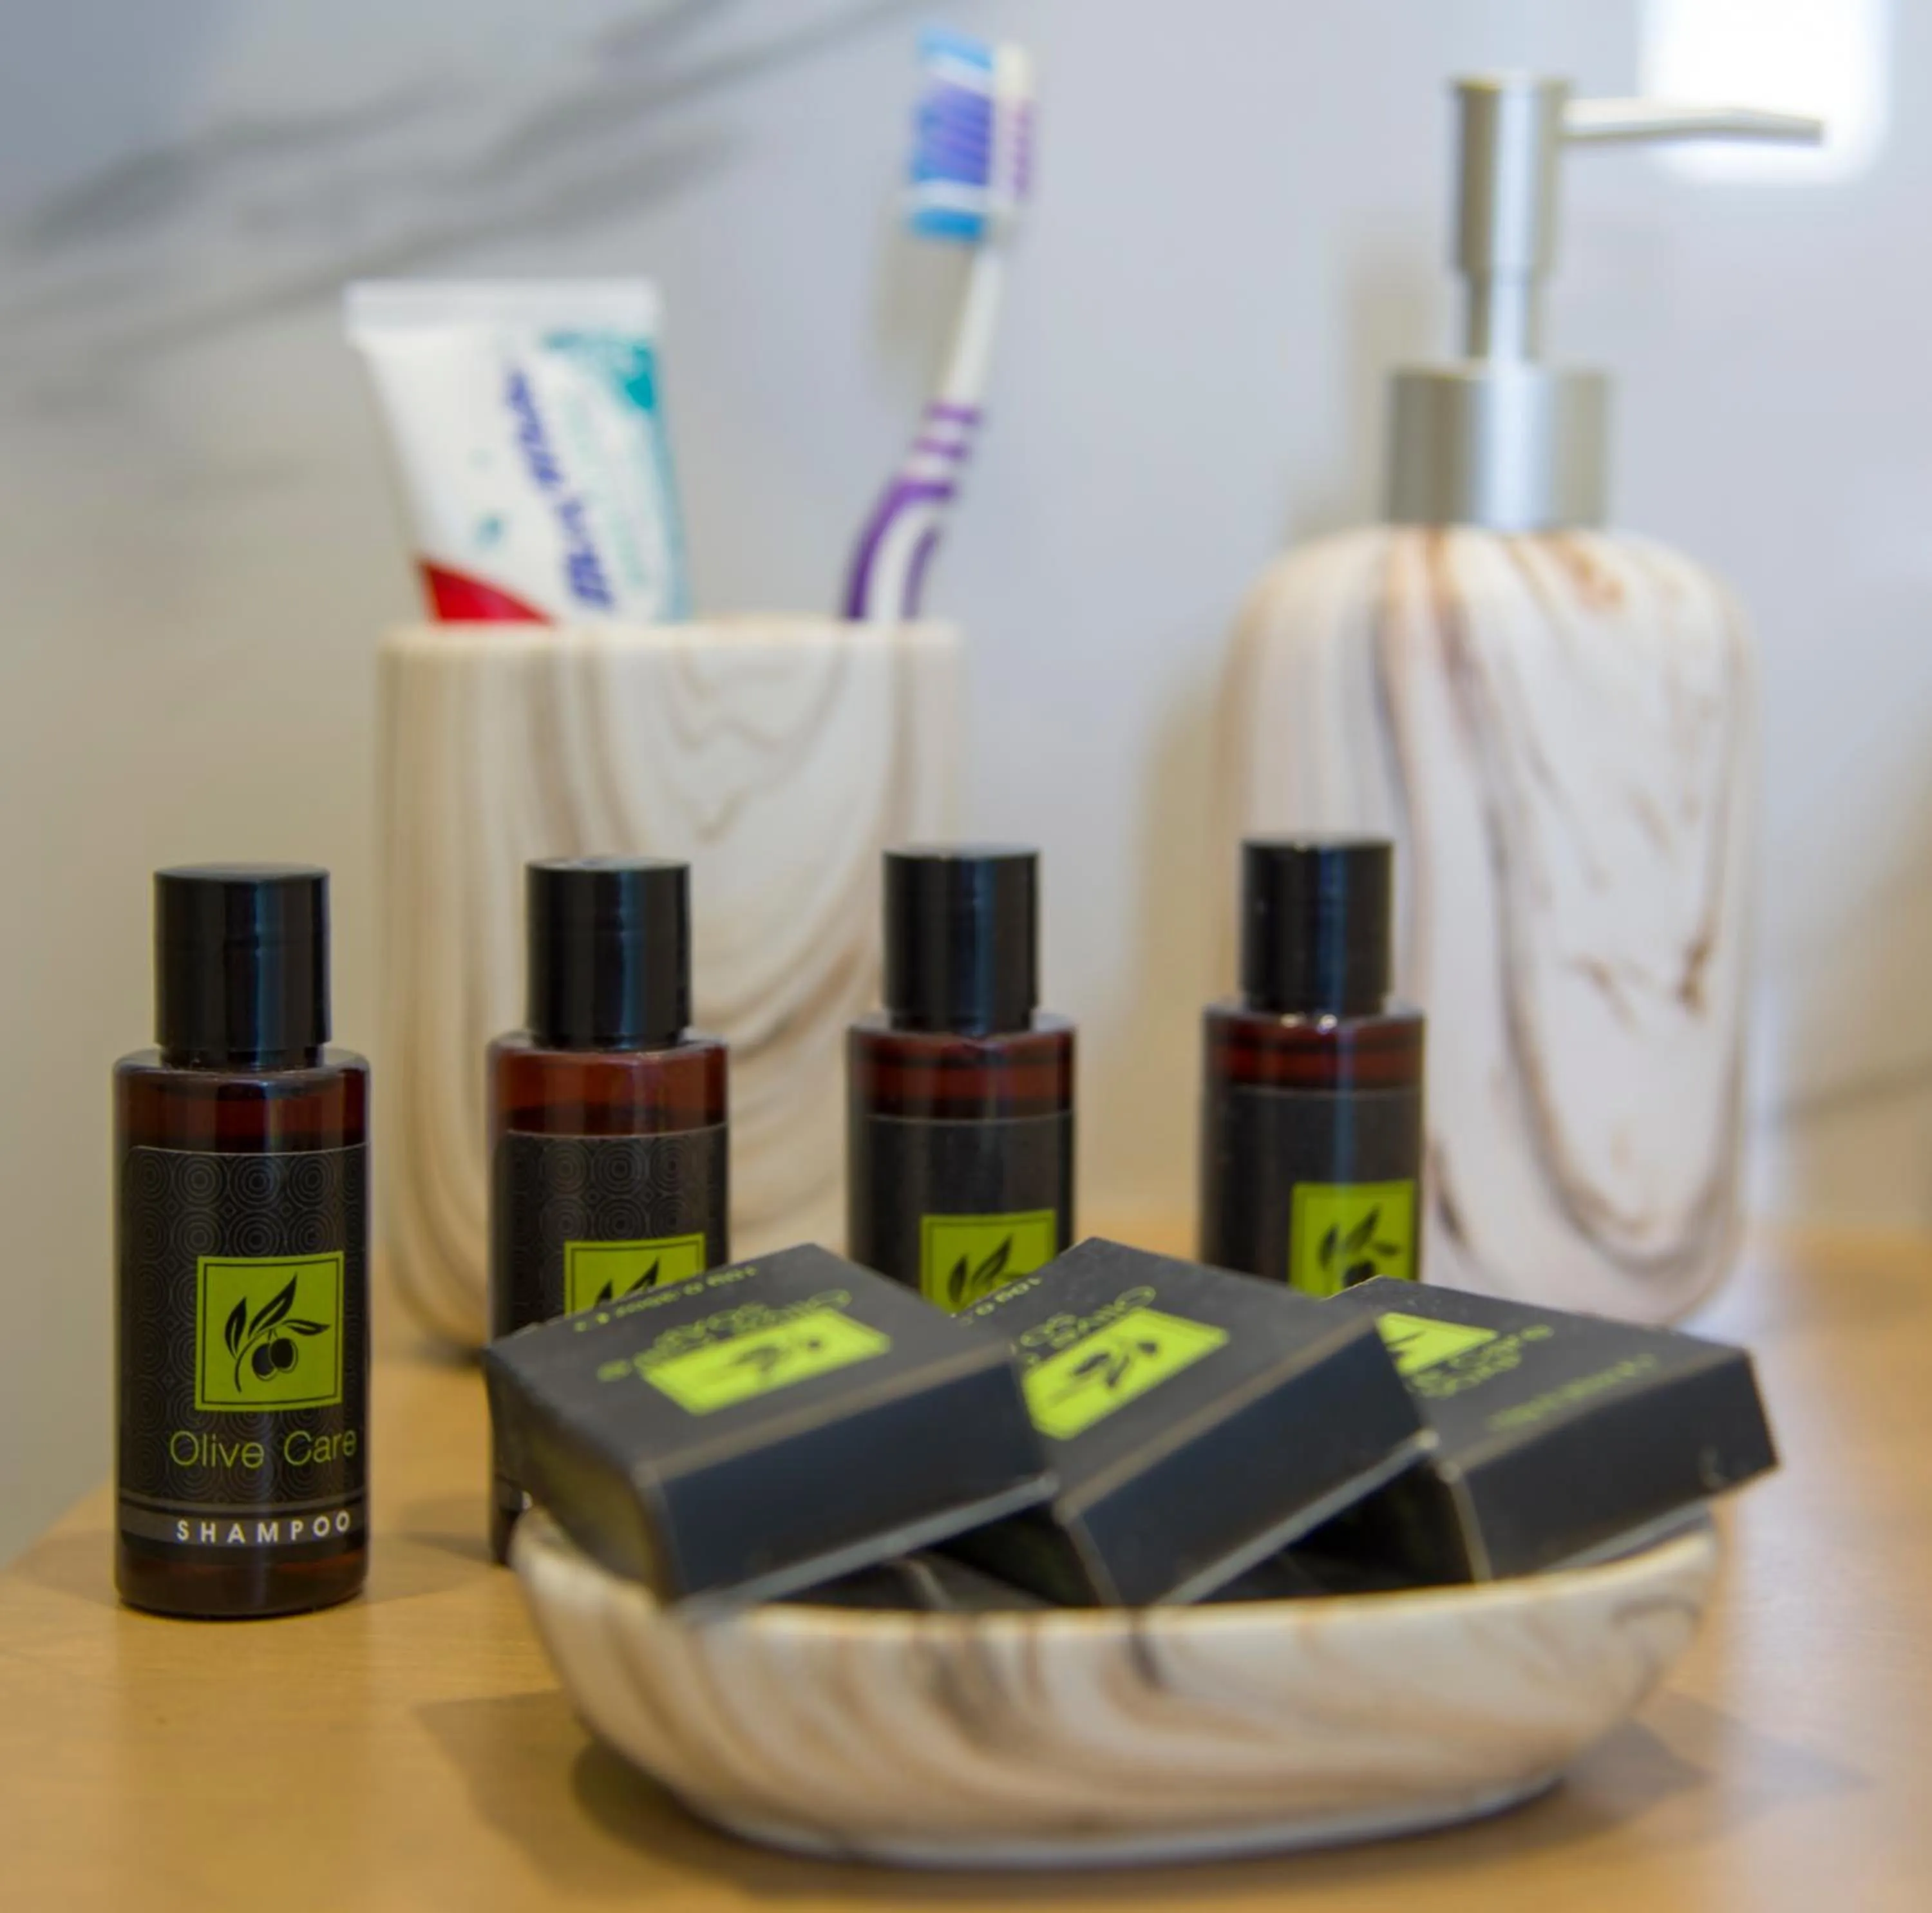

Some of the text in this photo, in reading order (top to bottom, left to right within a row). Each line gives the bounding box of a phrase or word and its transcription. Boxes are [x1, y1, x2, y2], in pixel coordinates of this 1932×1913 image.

[170, 1430, 357, 1468] Olive Care
[176, 1510, 351, 1543] SHAMPOO
